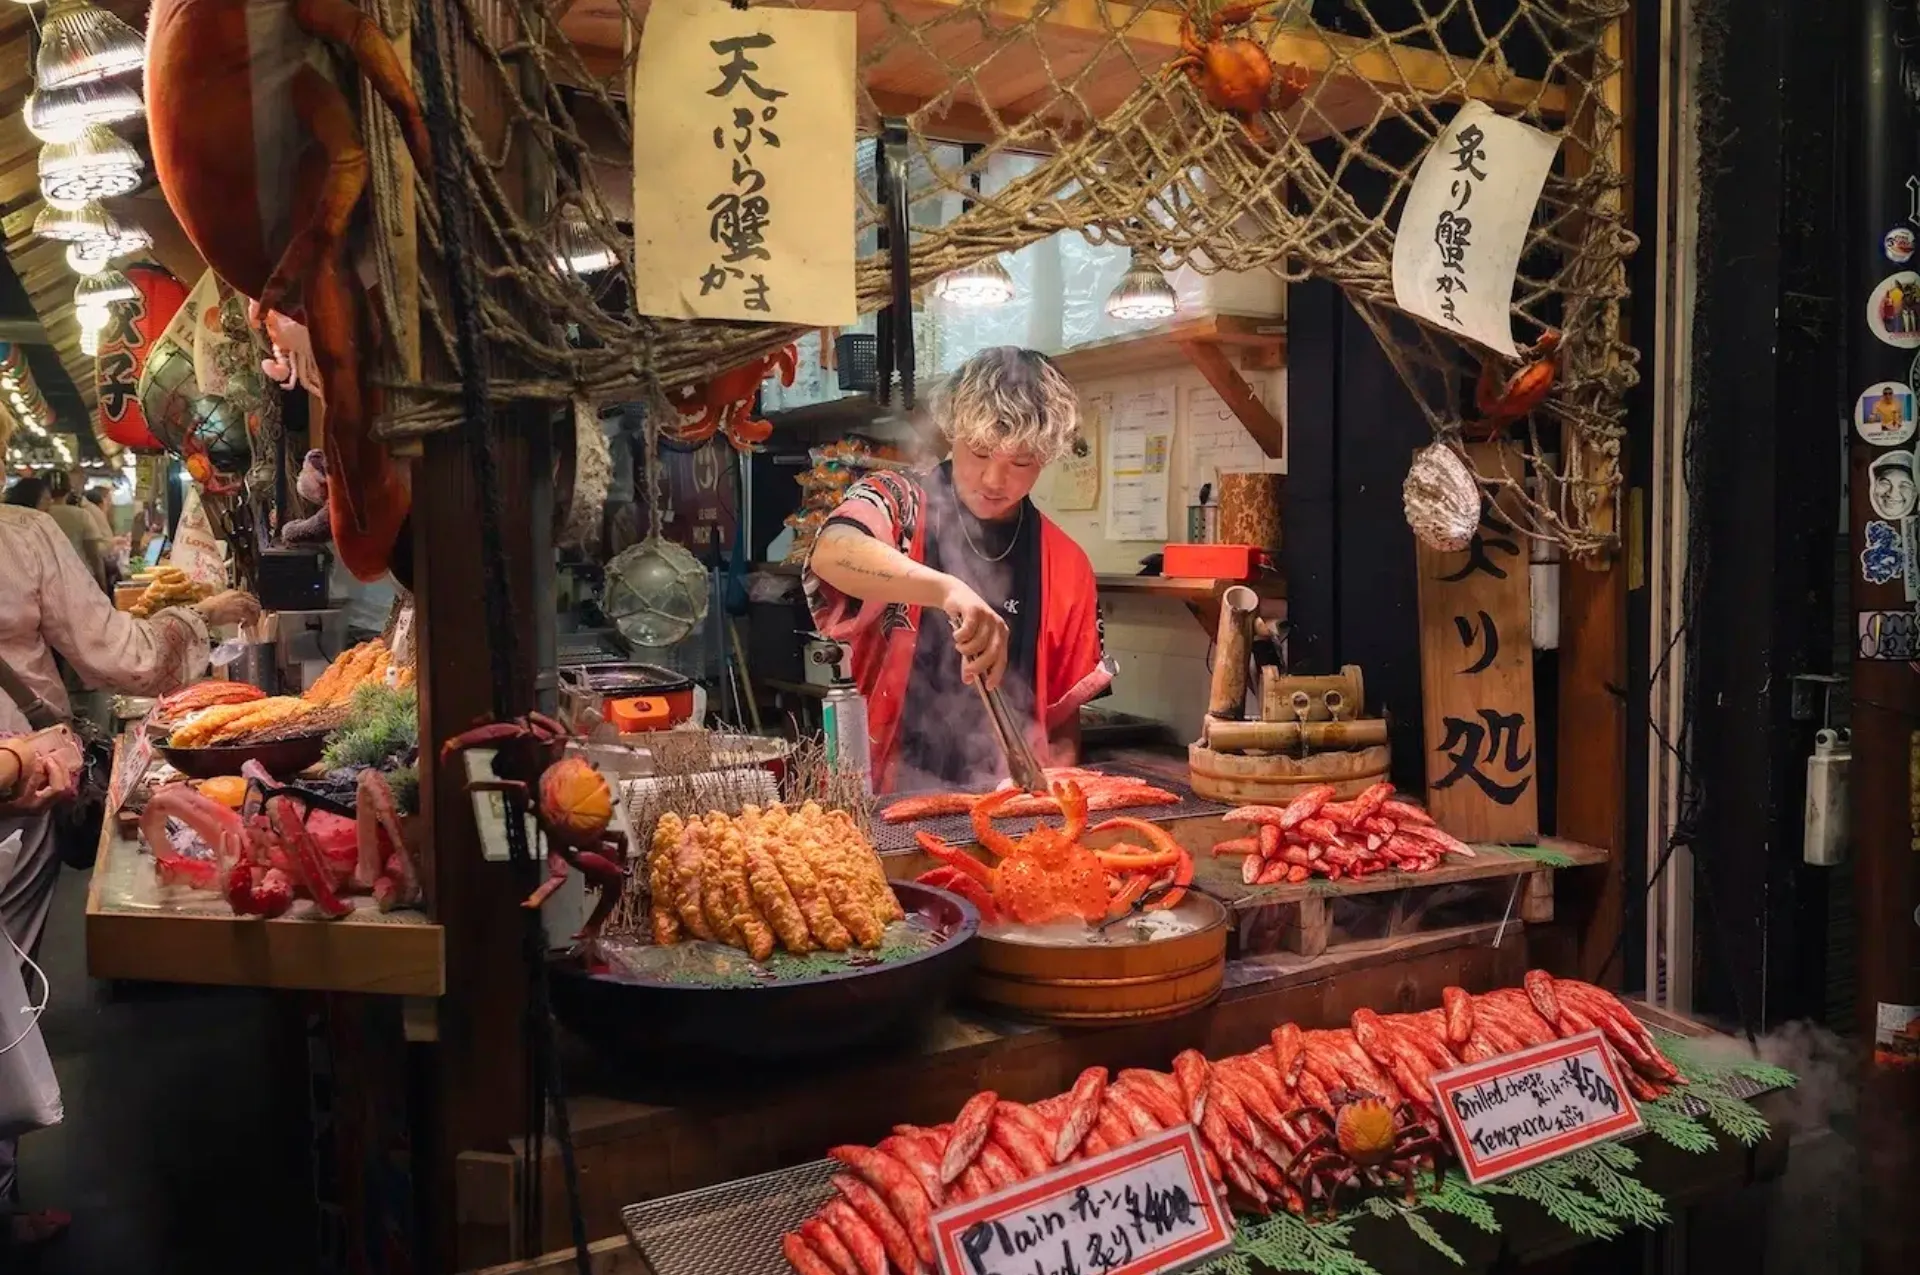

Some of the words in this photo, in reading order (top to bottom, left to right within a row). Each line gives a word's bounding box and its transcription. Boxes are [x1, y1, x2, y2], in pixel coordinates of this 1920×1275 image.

[699, 32, 790, 313] 天ぷら蟹かま
[1434, 123, 1488, 326] 炙り蟹かま
[1471, 1112, 1553, 1156] Tempura
[960, 1212, 1065, 1275] Plain
